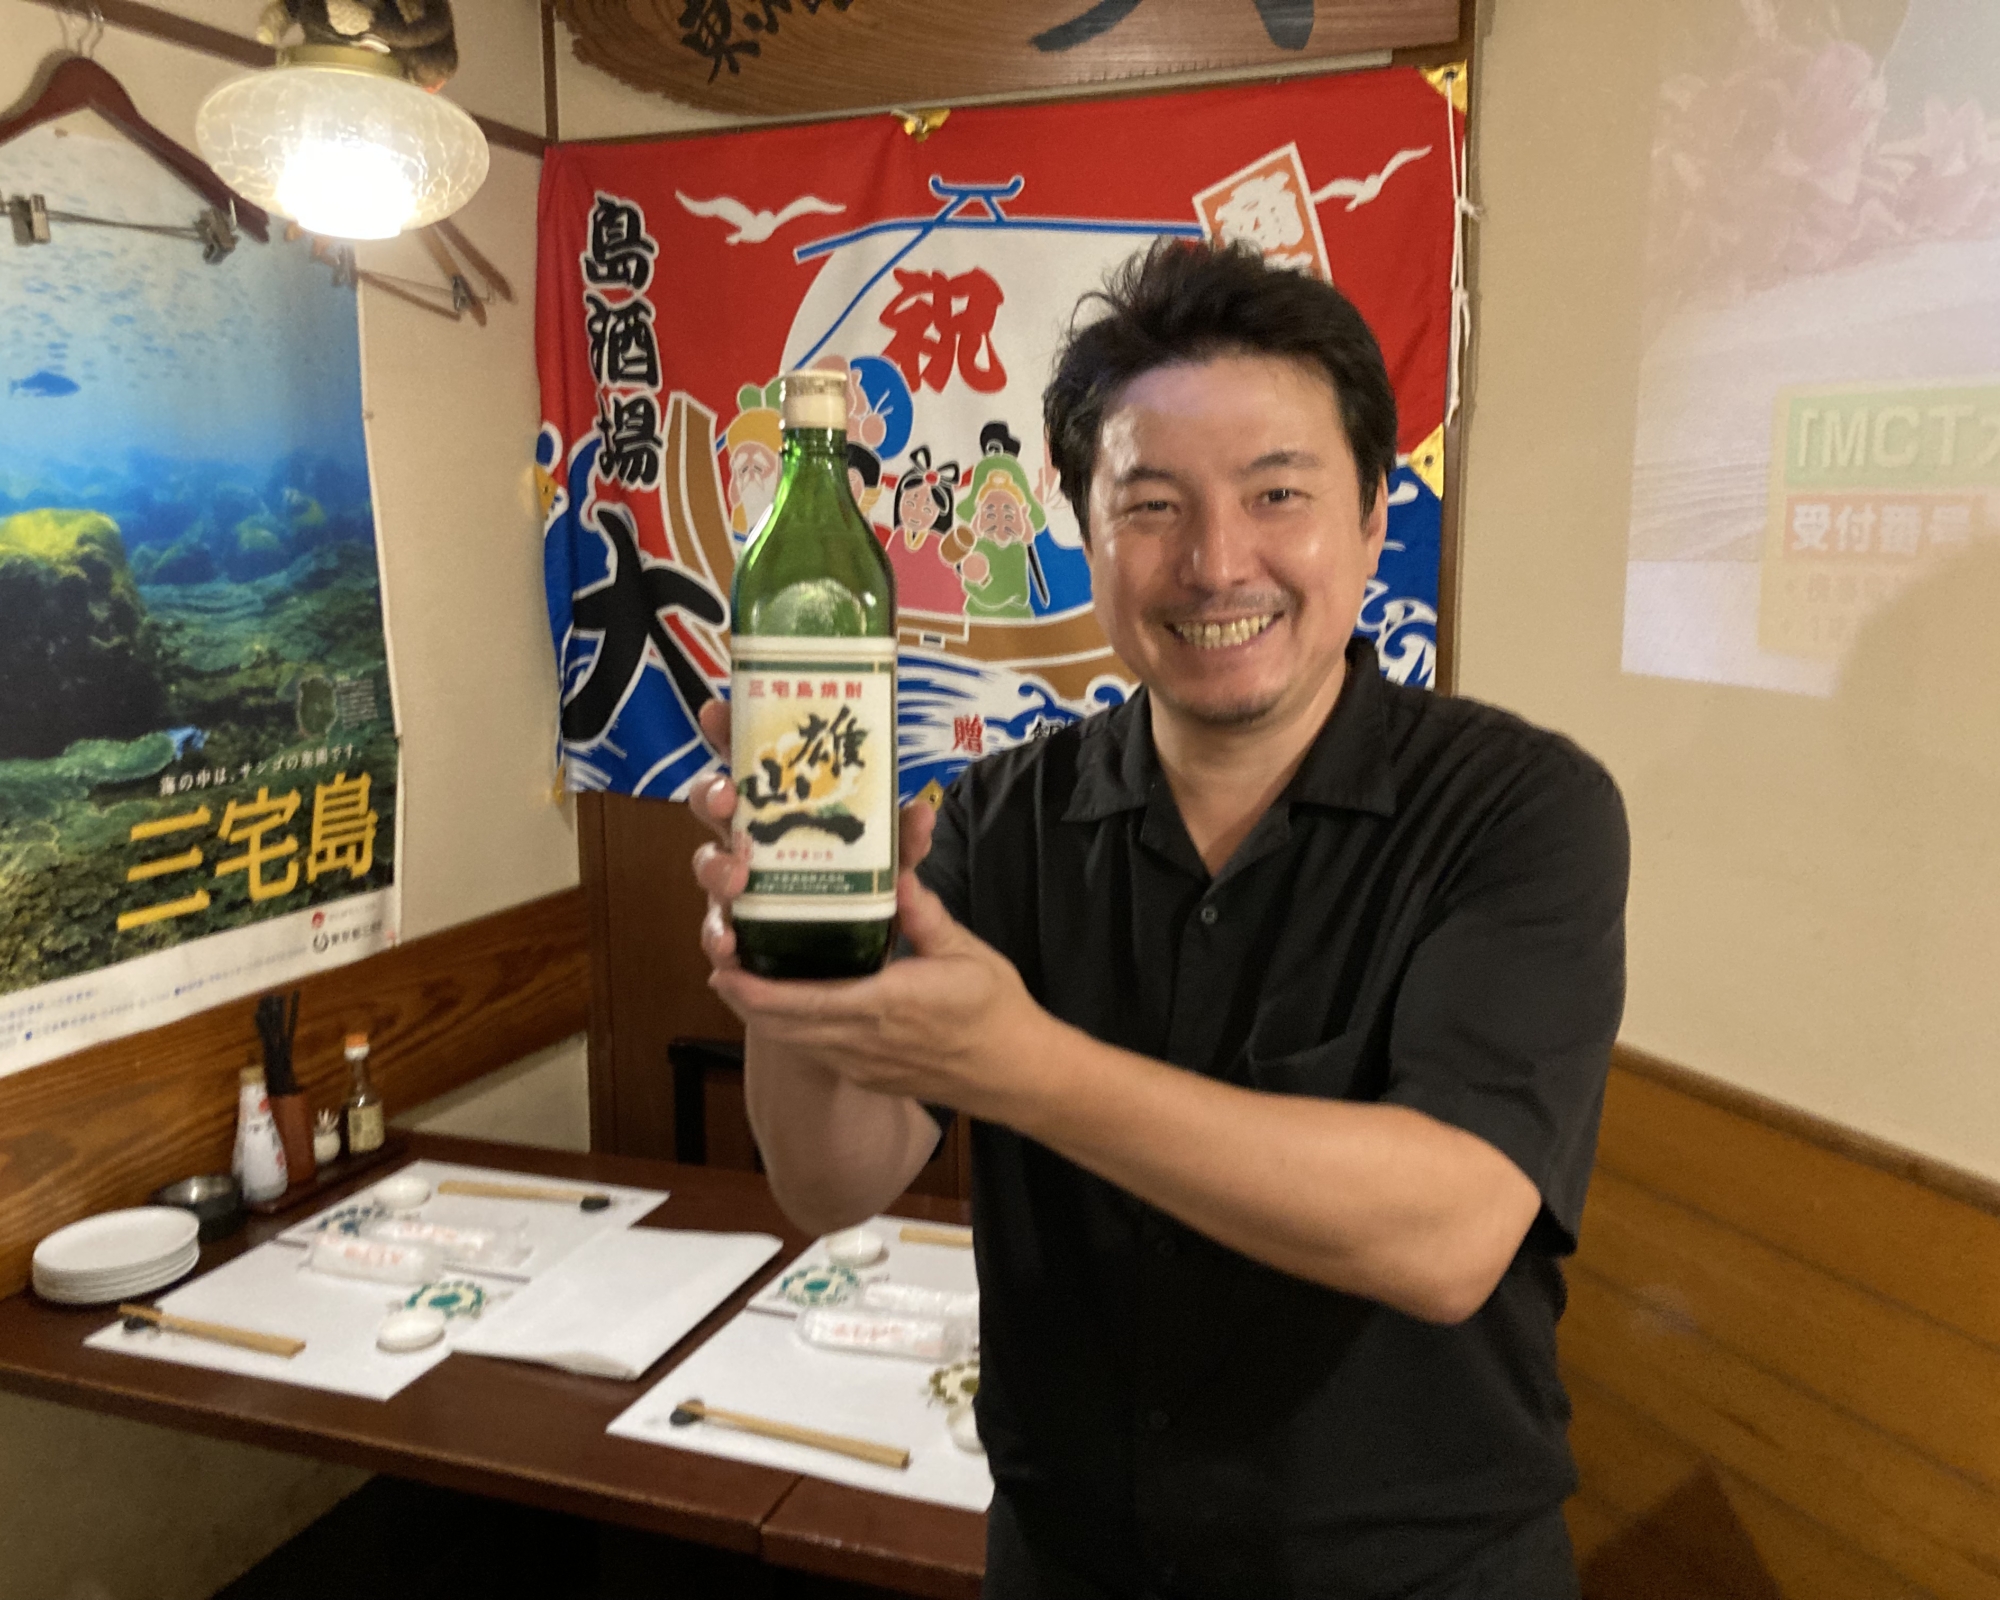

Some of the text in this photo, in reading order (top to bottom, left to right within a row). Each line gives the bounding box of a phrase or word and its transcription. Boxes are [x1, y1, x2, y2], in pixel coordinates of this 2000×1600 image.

[582, 193, 663, 487] 島酒場
[878, 266, 1008, 394] 祝
[952, 714, 984, 754] 贈
[117, 771, 379, 933] 三宅島
